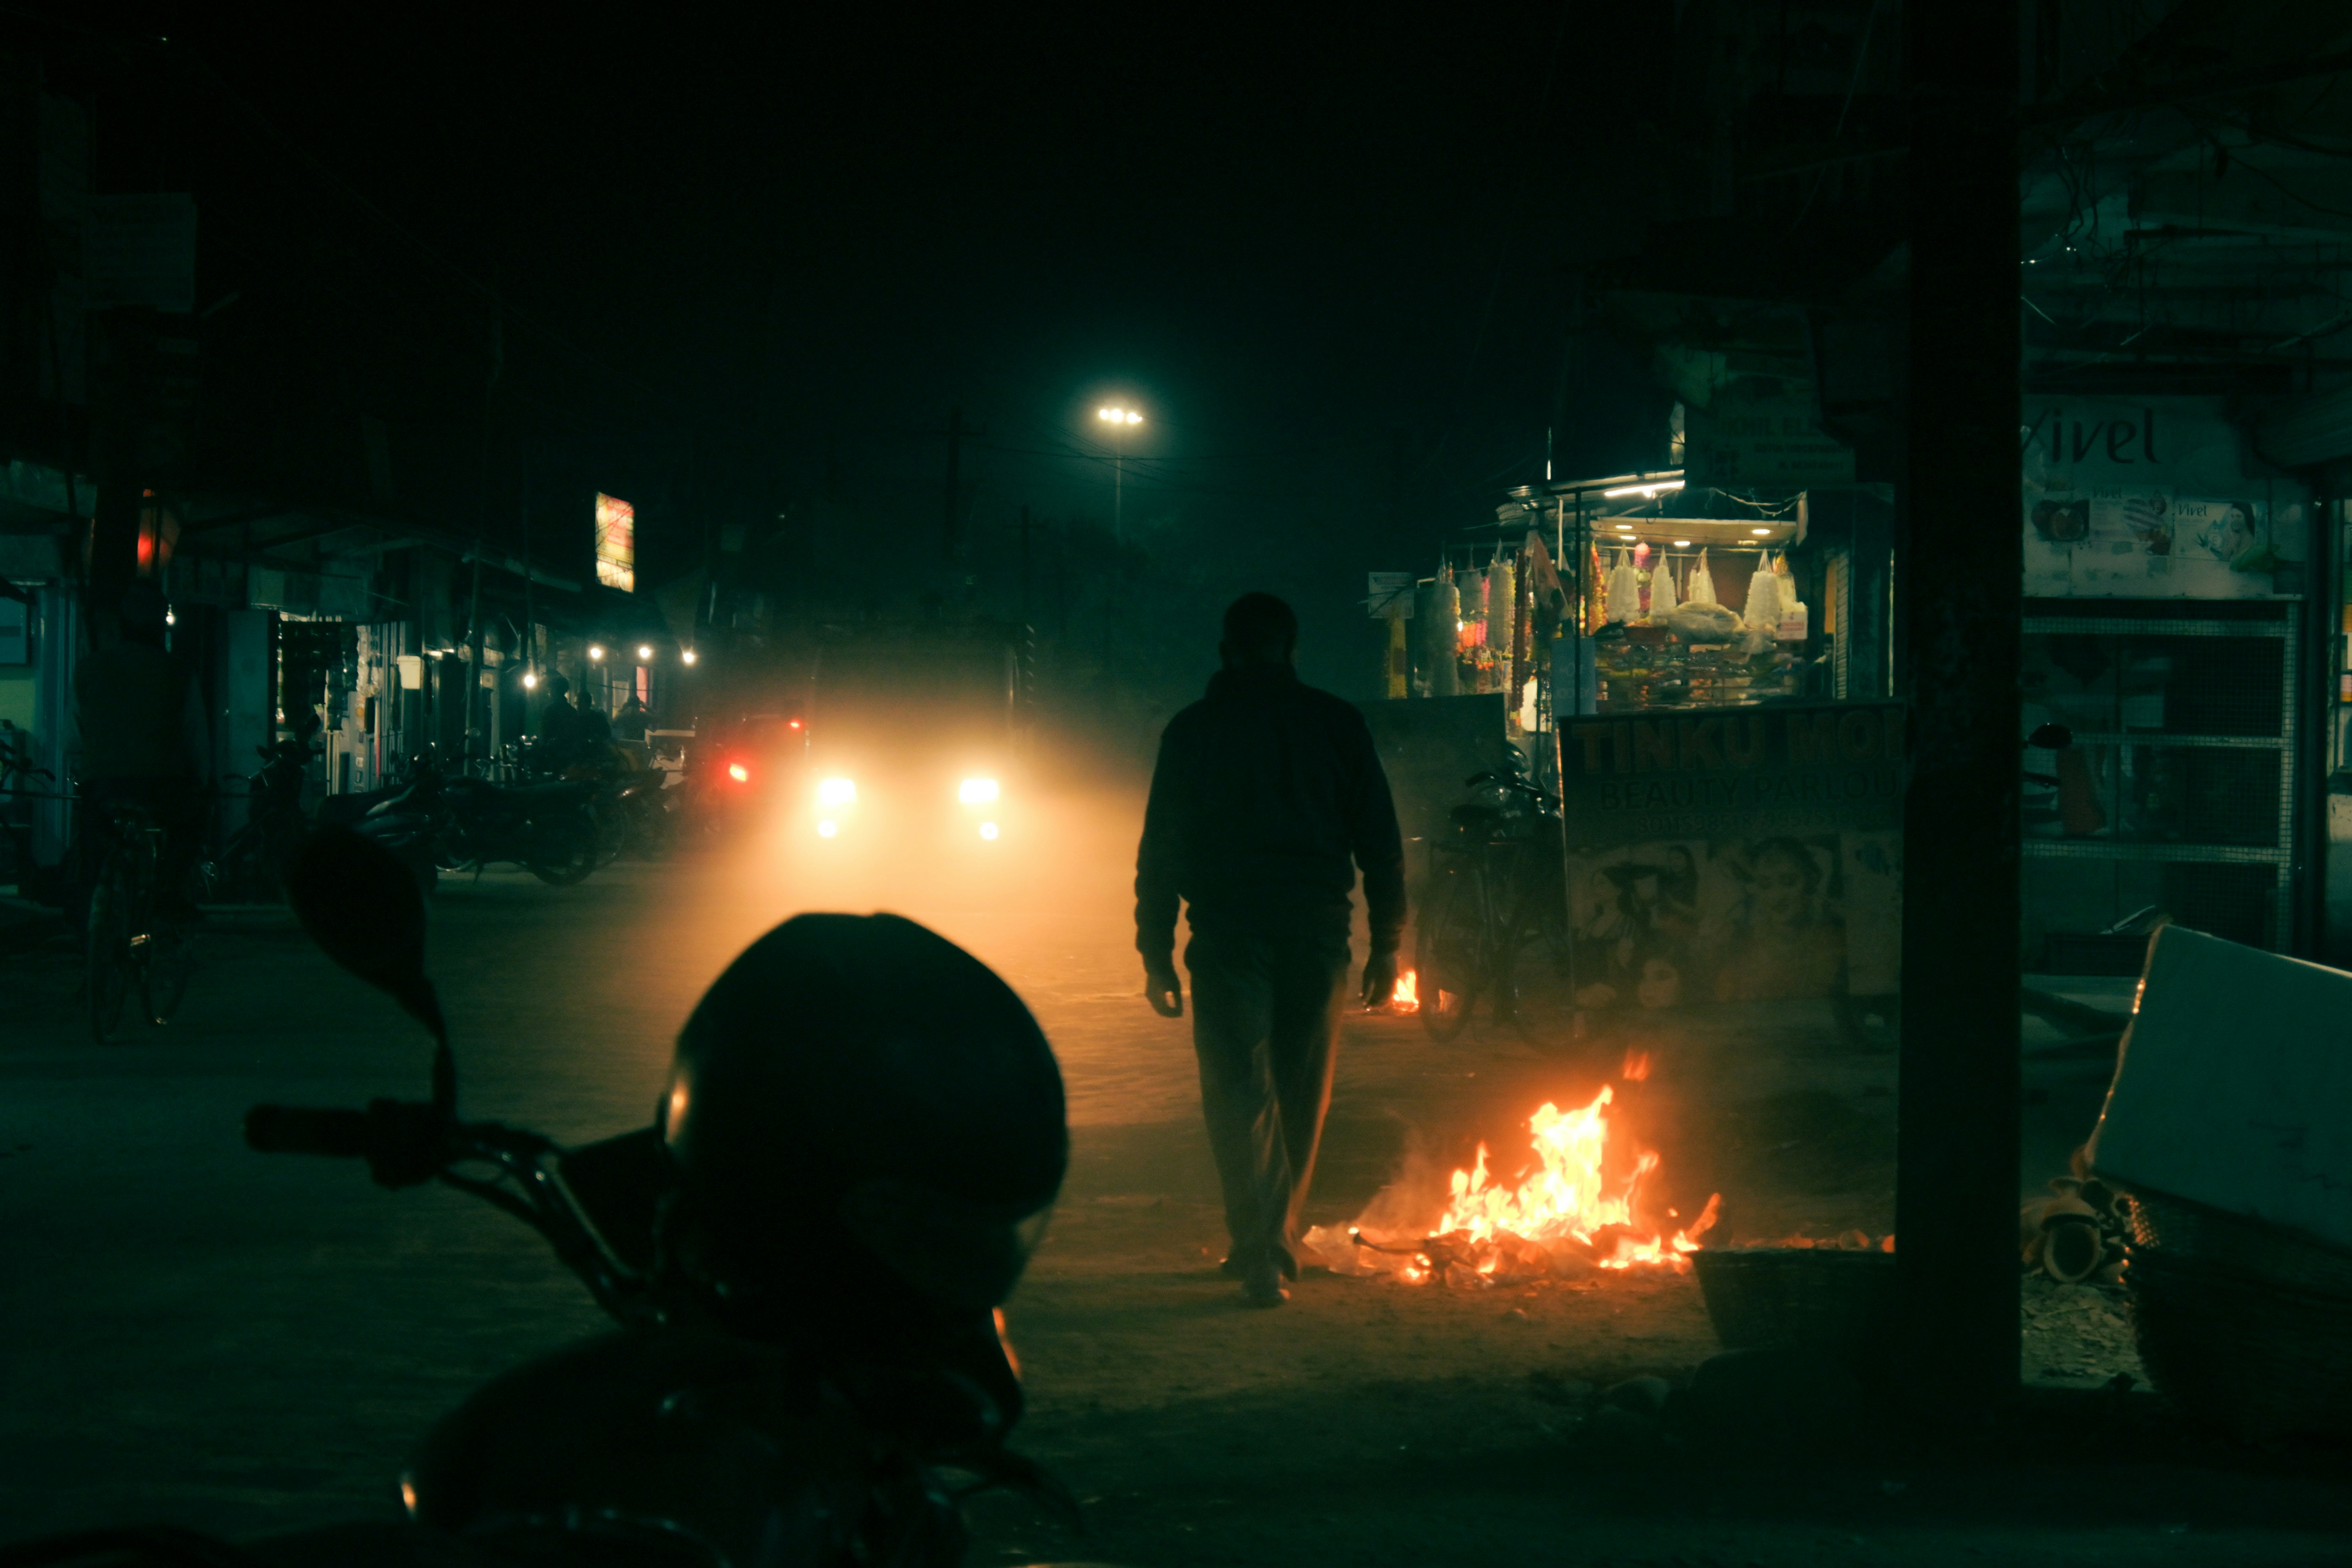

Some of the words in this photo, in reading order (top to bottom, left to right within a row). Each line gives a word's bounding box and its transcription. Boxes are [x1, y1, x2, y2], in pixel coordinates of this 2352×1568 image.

[2093, 486, 2122, 499] Vivel
[2178, 504, 2207, 517] Vivel
[1572, 714, 1767, 775] TINKU
[1601, 776, 1740, 811] BEAUTY
